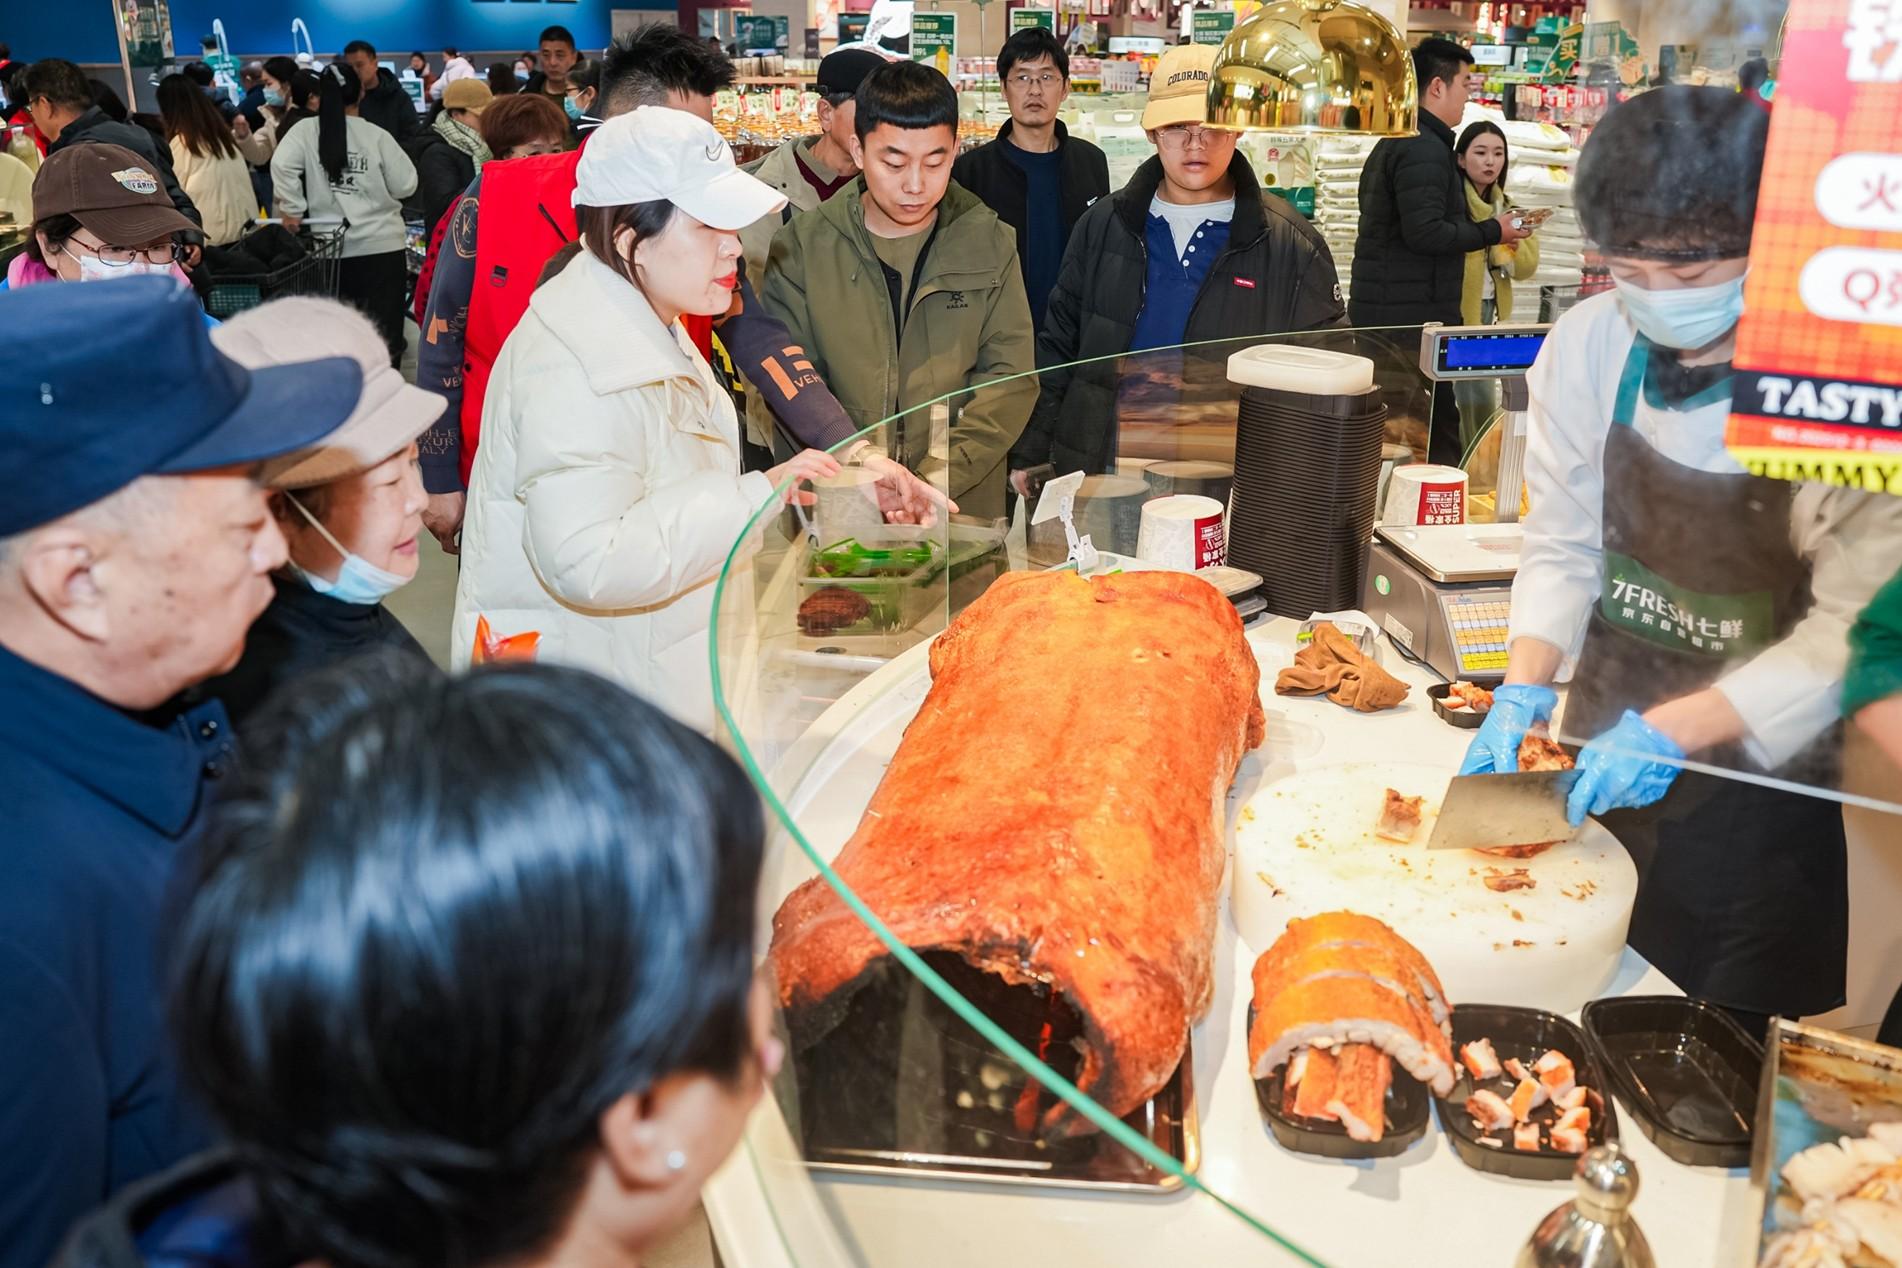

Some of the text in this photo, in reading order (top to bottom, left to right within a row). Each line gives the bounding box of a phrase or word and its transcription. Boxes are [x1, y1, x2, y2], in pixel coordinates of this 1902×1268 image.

[1560, 39, 1578, 60] 买
[1167, 69, 1209, 86] COLORADO
[1756, 375, 1902, 427] TASTY
[1452, 489, 1461, 524] SUPER
[1612, 578, 1743, 639] 7FRESH 七鲜
